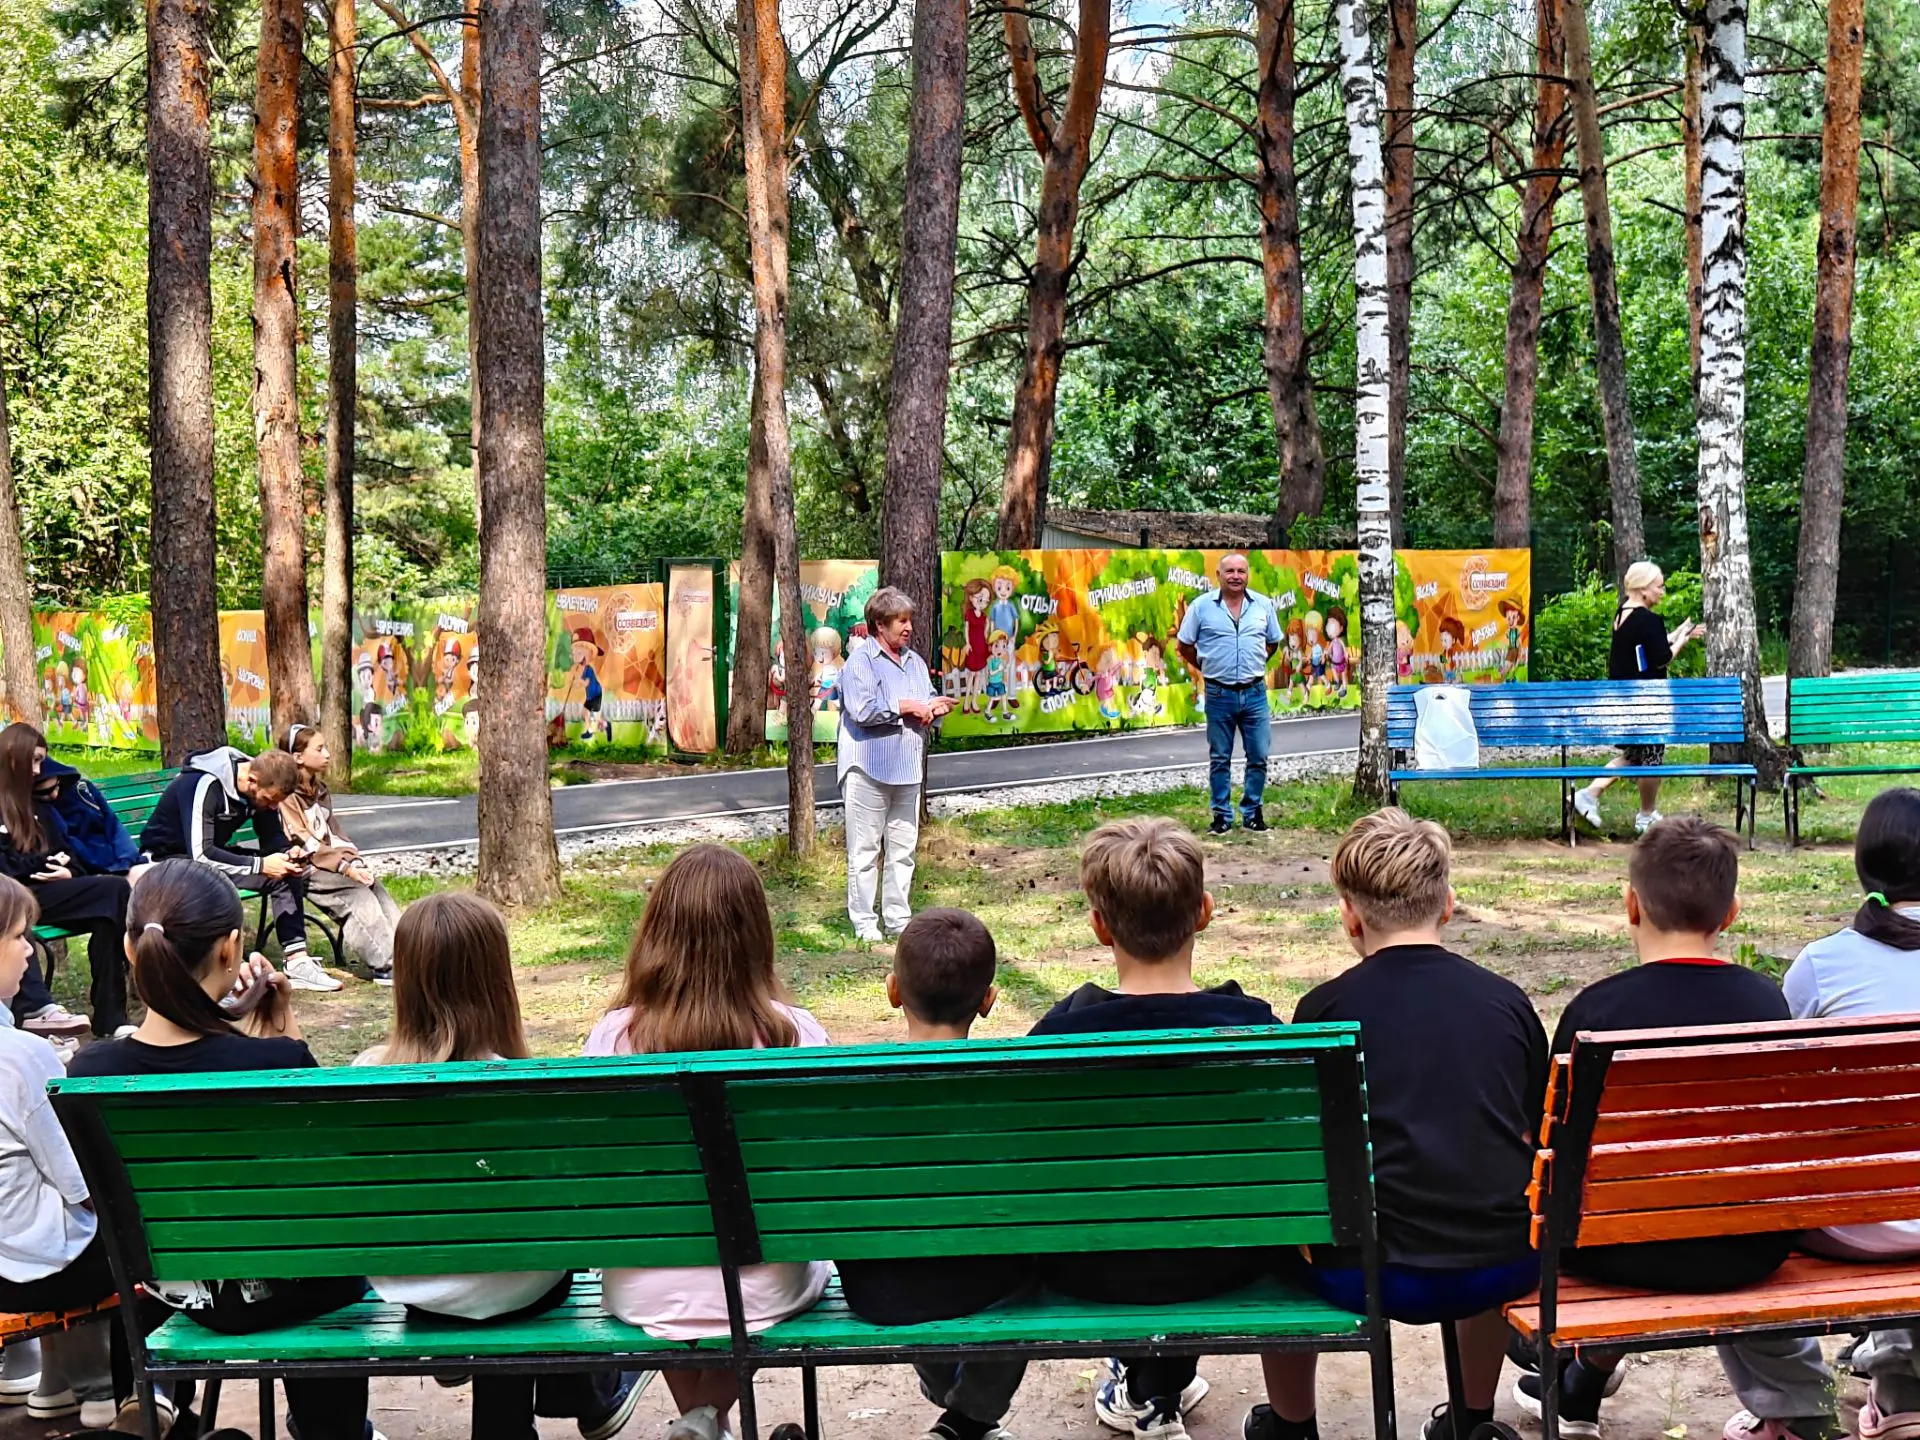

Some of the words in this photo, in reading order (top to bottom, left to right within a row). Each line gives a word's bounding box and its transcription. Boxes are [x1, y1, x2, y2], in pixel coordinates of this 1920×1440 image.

[1020, 594, 1058, 614] ОТДЫХ
[1088, 576, 1156, 607] ПРИКЛЮЧЕНИЯ
[1040, 688, 1076, 713] СПОРТ
